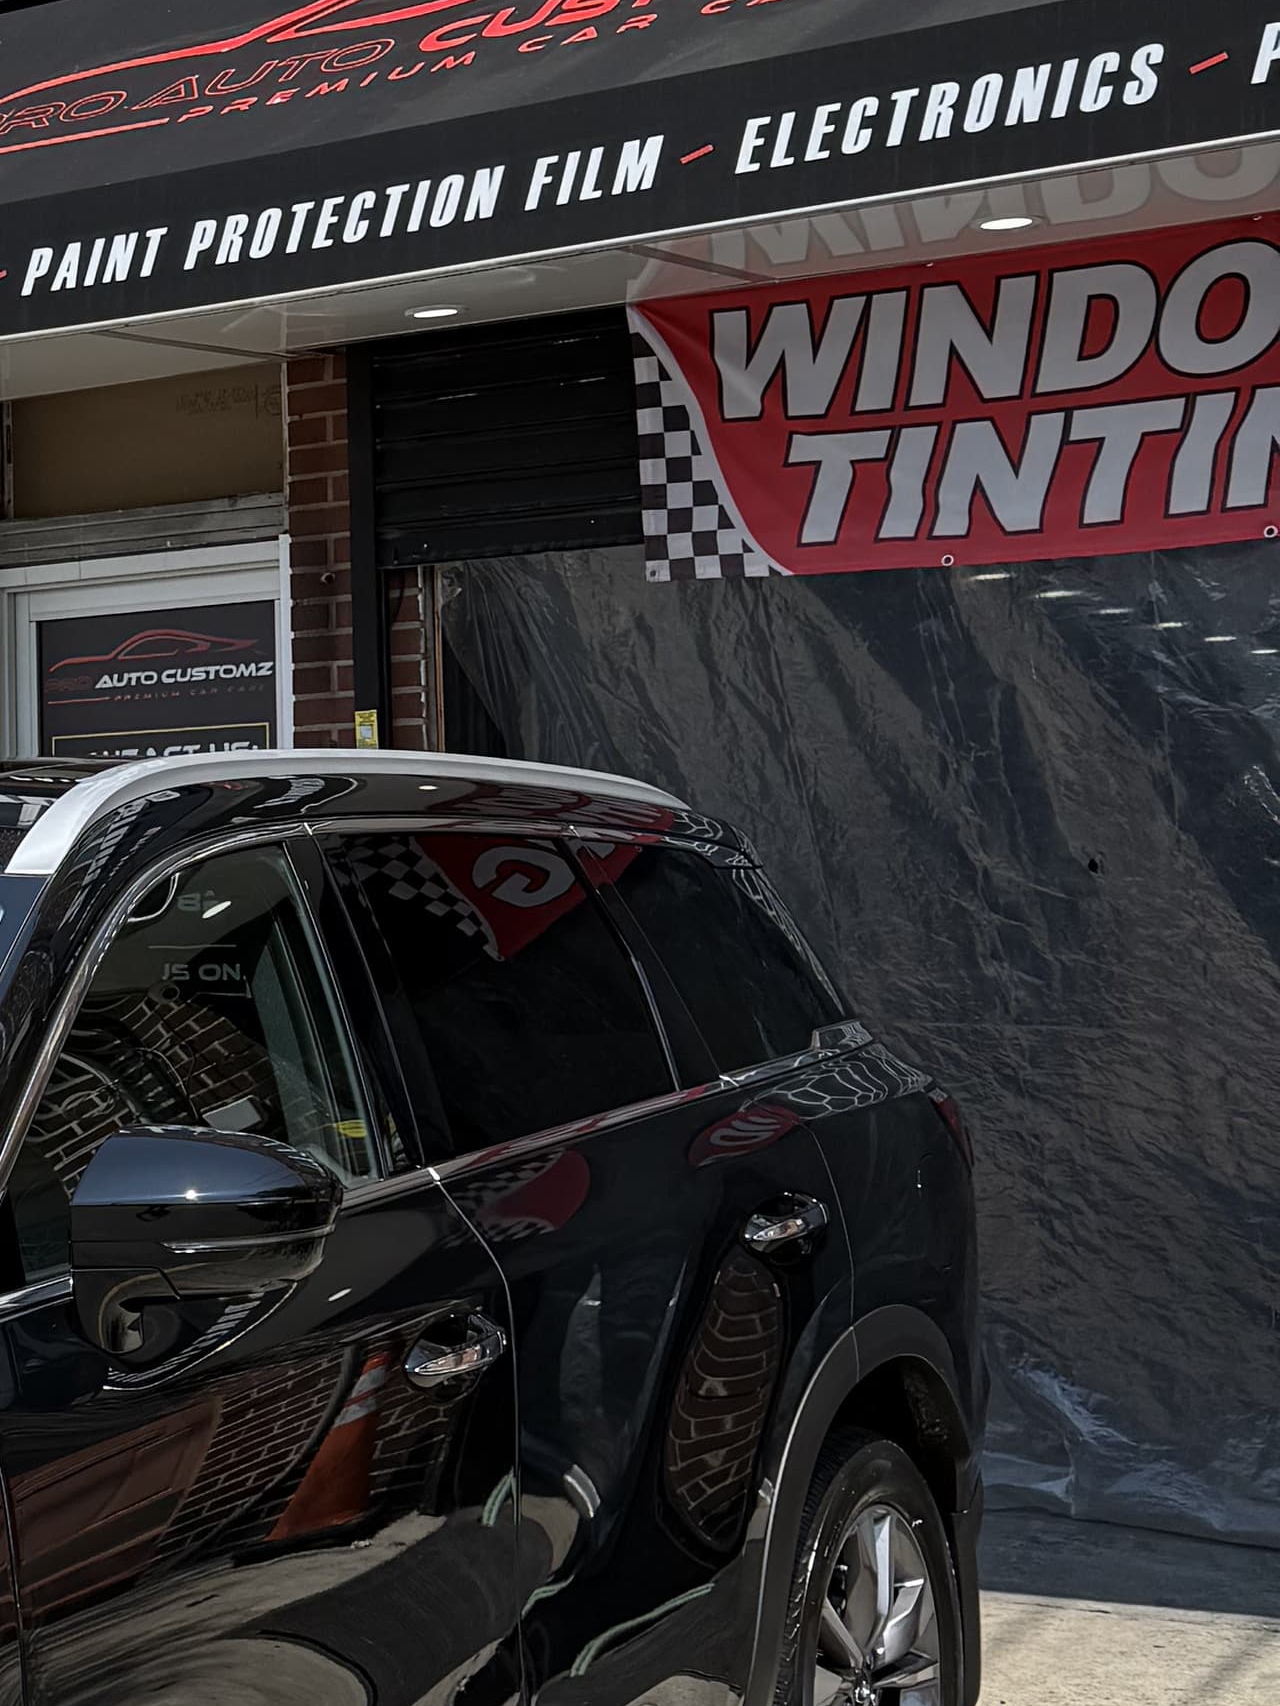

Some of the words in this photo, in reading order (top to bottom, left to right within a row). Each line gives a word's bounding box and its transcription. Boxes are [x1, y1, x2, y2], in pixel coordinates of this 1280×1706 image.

[134, 38, 397, 110] AUTO
[178, 50, 477, 124] PREMIUM
[518, 13, 658, 54] CAR
[21, 225, 170, 299] PAINT
[182, 163, 509, 275] PROTECTION
[524, 134, 666, 215] FILM
[734, 42, 1166, 177] ELECTRONICS
[95, 670, 159, 690] AUTO
[161, 661, 274, 684] CUSTOMZ
